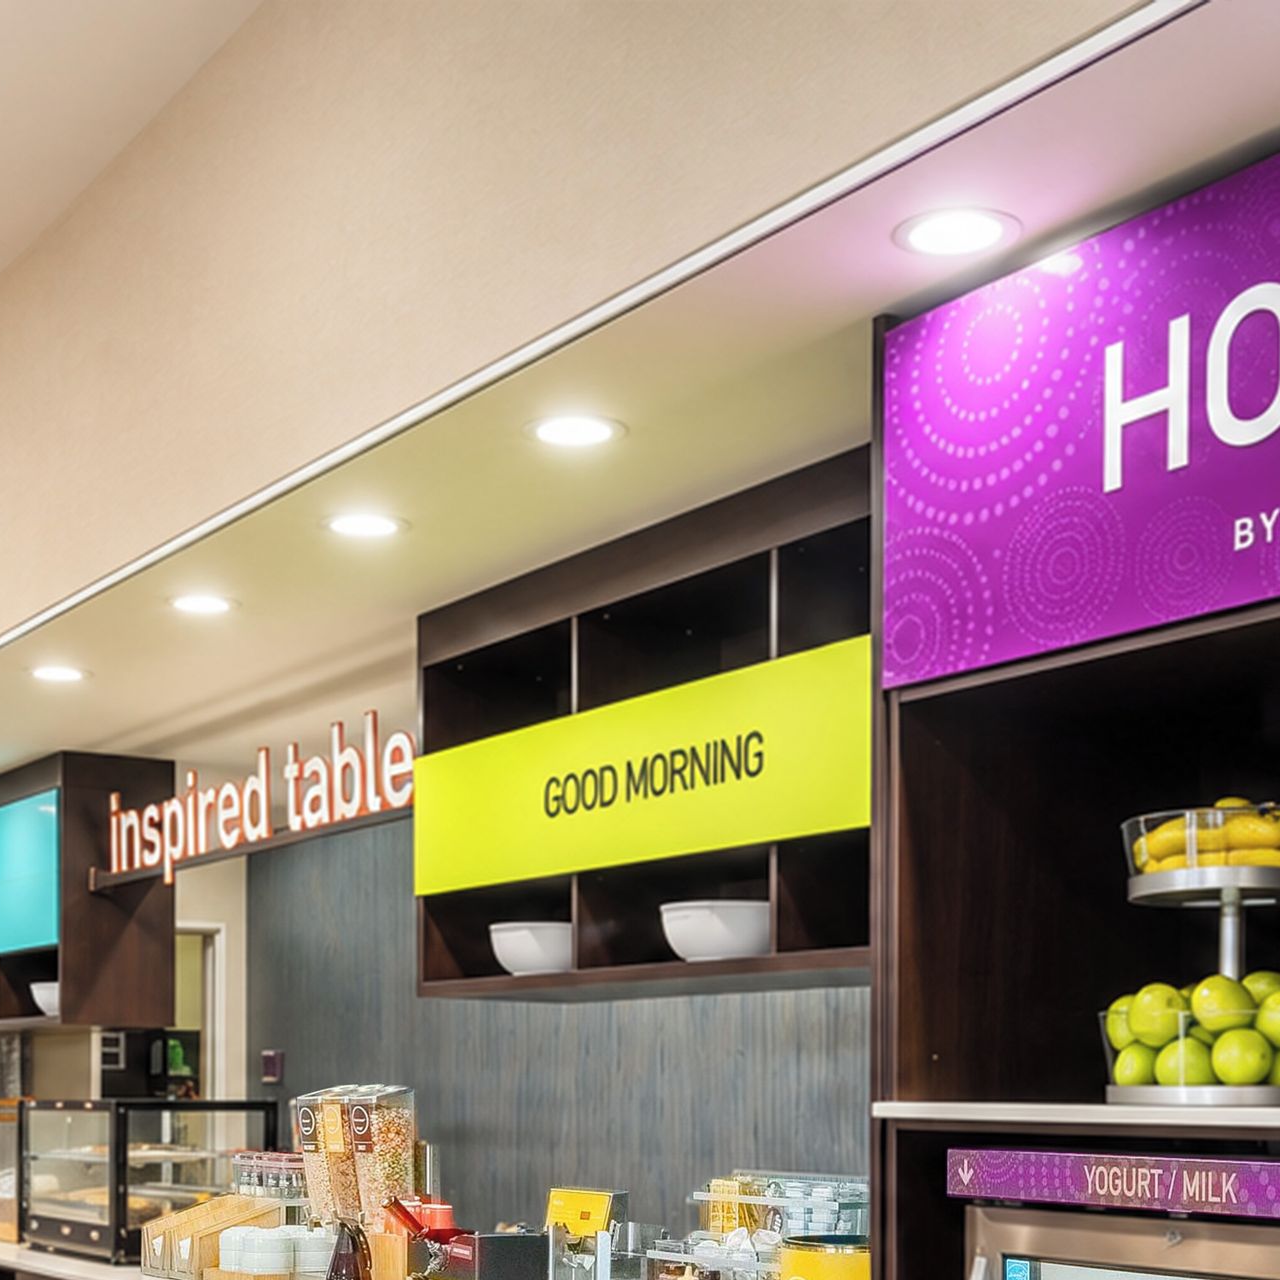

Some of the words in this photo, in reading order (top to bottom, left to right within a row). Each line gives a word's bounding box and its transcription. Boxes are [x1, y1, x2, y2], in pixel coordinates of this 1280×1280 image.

[110, 746, 272, 885] inspired
[283, 709, 416, 832] table
[544, 764, 619, 819] GOOD
[625, 730, 765, 803] MORNING
[1083, 1165, 1164, 1199] YOGURT
[1182, 1169, 1238, 1204] MILK
